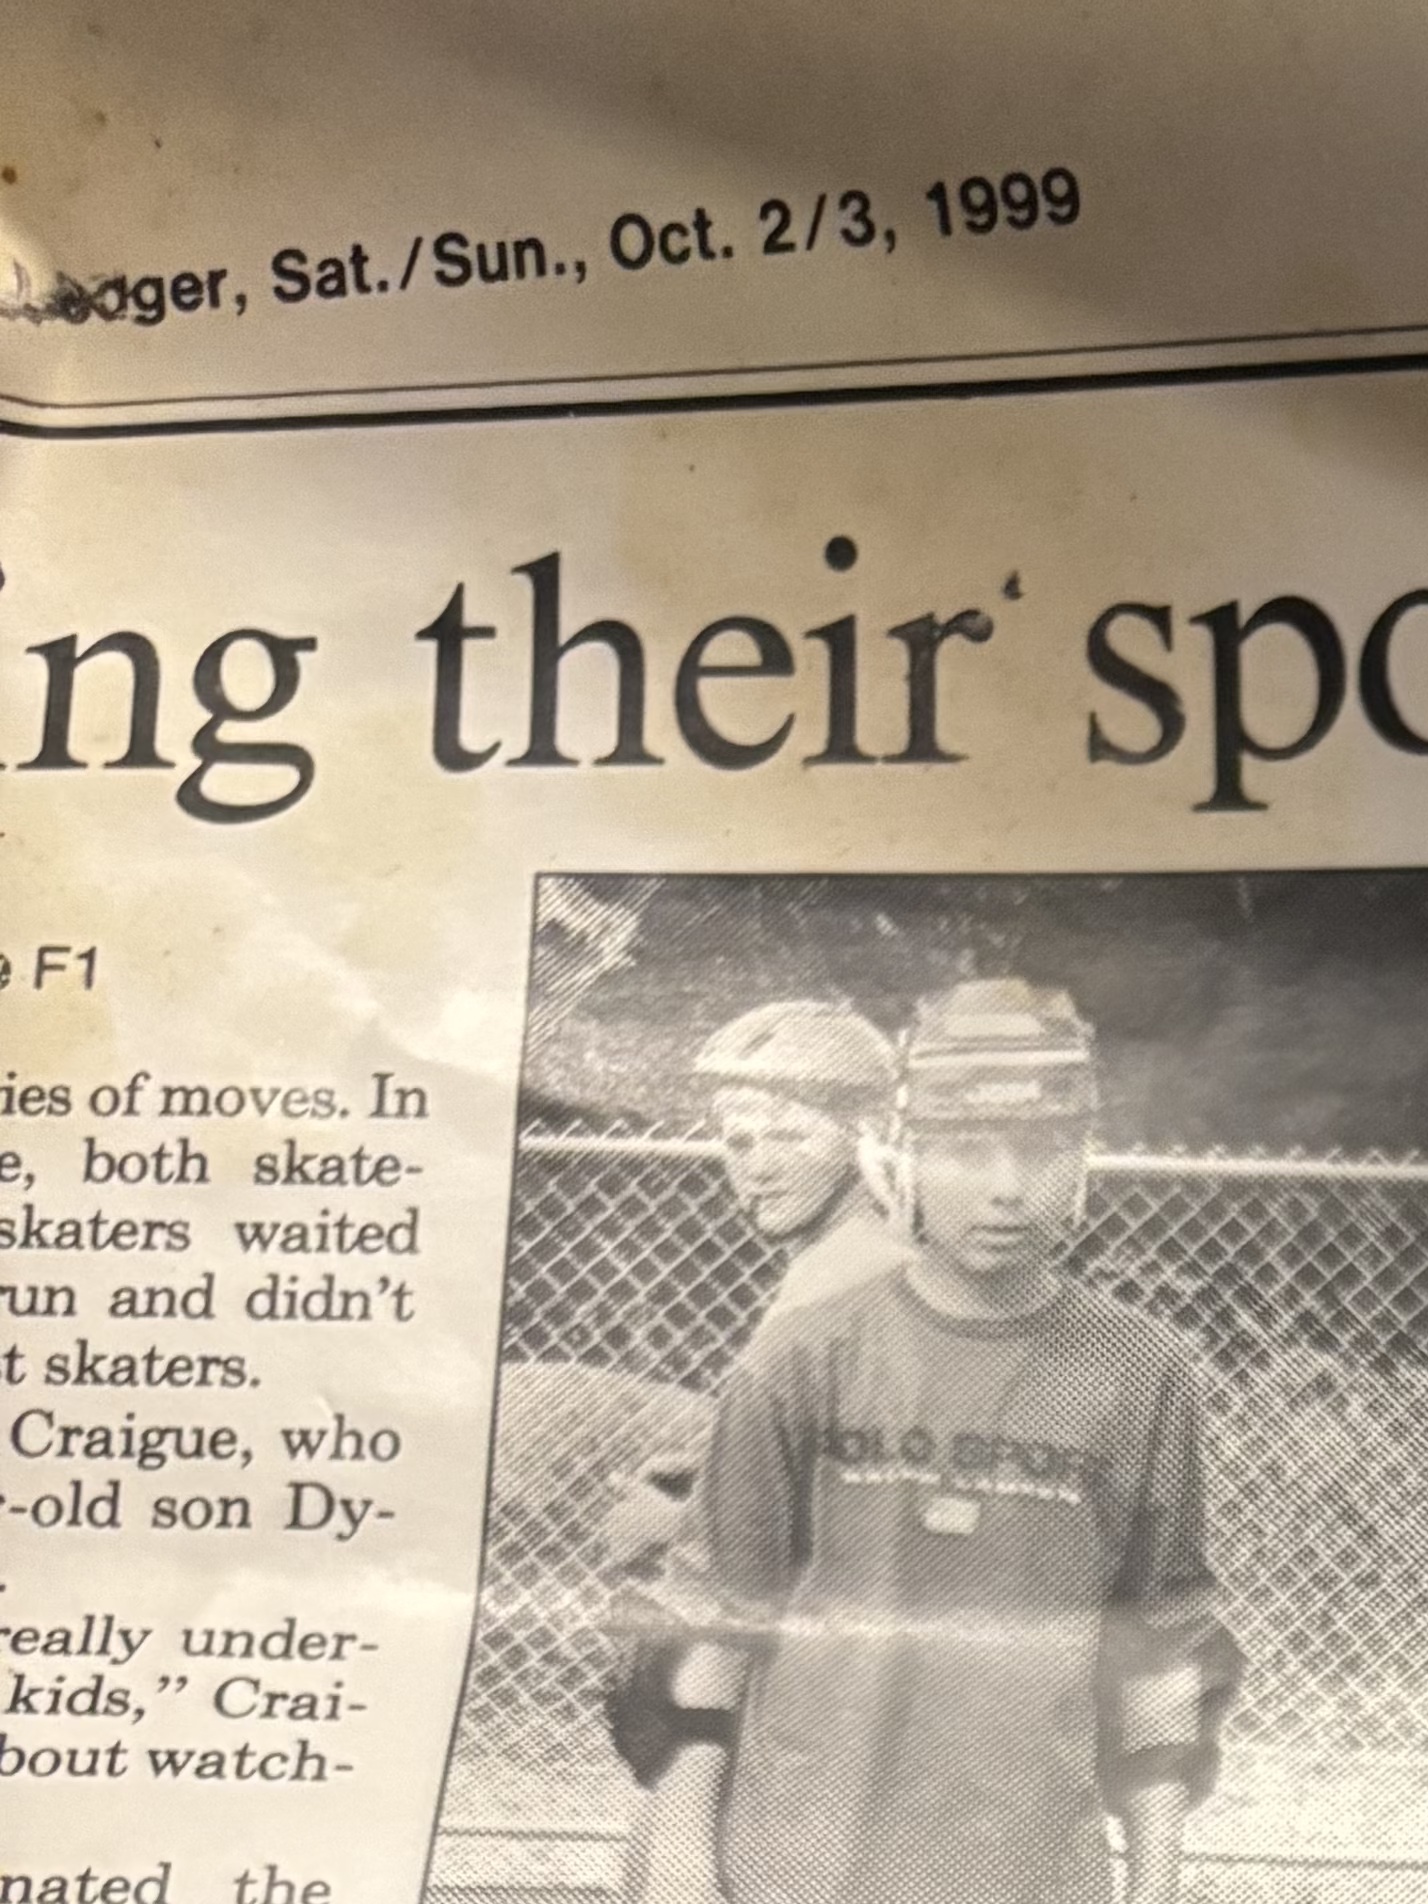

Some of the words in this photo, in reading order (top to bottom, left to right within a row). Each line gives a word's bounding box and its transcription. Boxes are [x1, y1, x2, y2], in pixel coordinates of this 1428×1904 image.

[608, 202, 735, 275] Oct.
[926, 166, 1083, 239] 1999
[0, 560, 319, 826] ng
[412, 532, 995, 775] their
[33, 944, 99, 990] F1
[88, 1071, 151, 1118] of
[159, 1086, 350, 1118] moves.
[369, 1072, 430, 1119] In
[9, 1408, 253, 1471] Craigue,
[280, 1412, 402, 1462] who
[213, 1676, 367, 1721] Crai-
